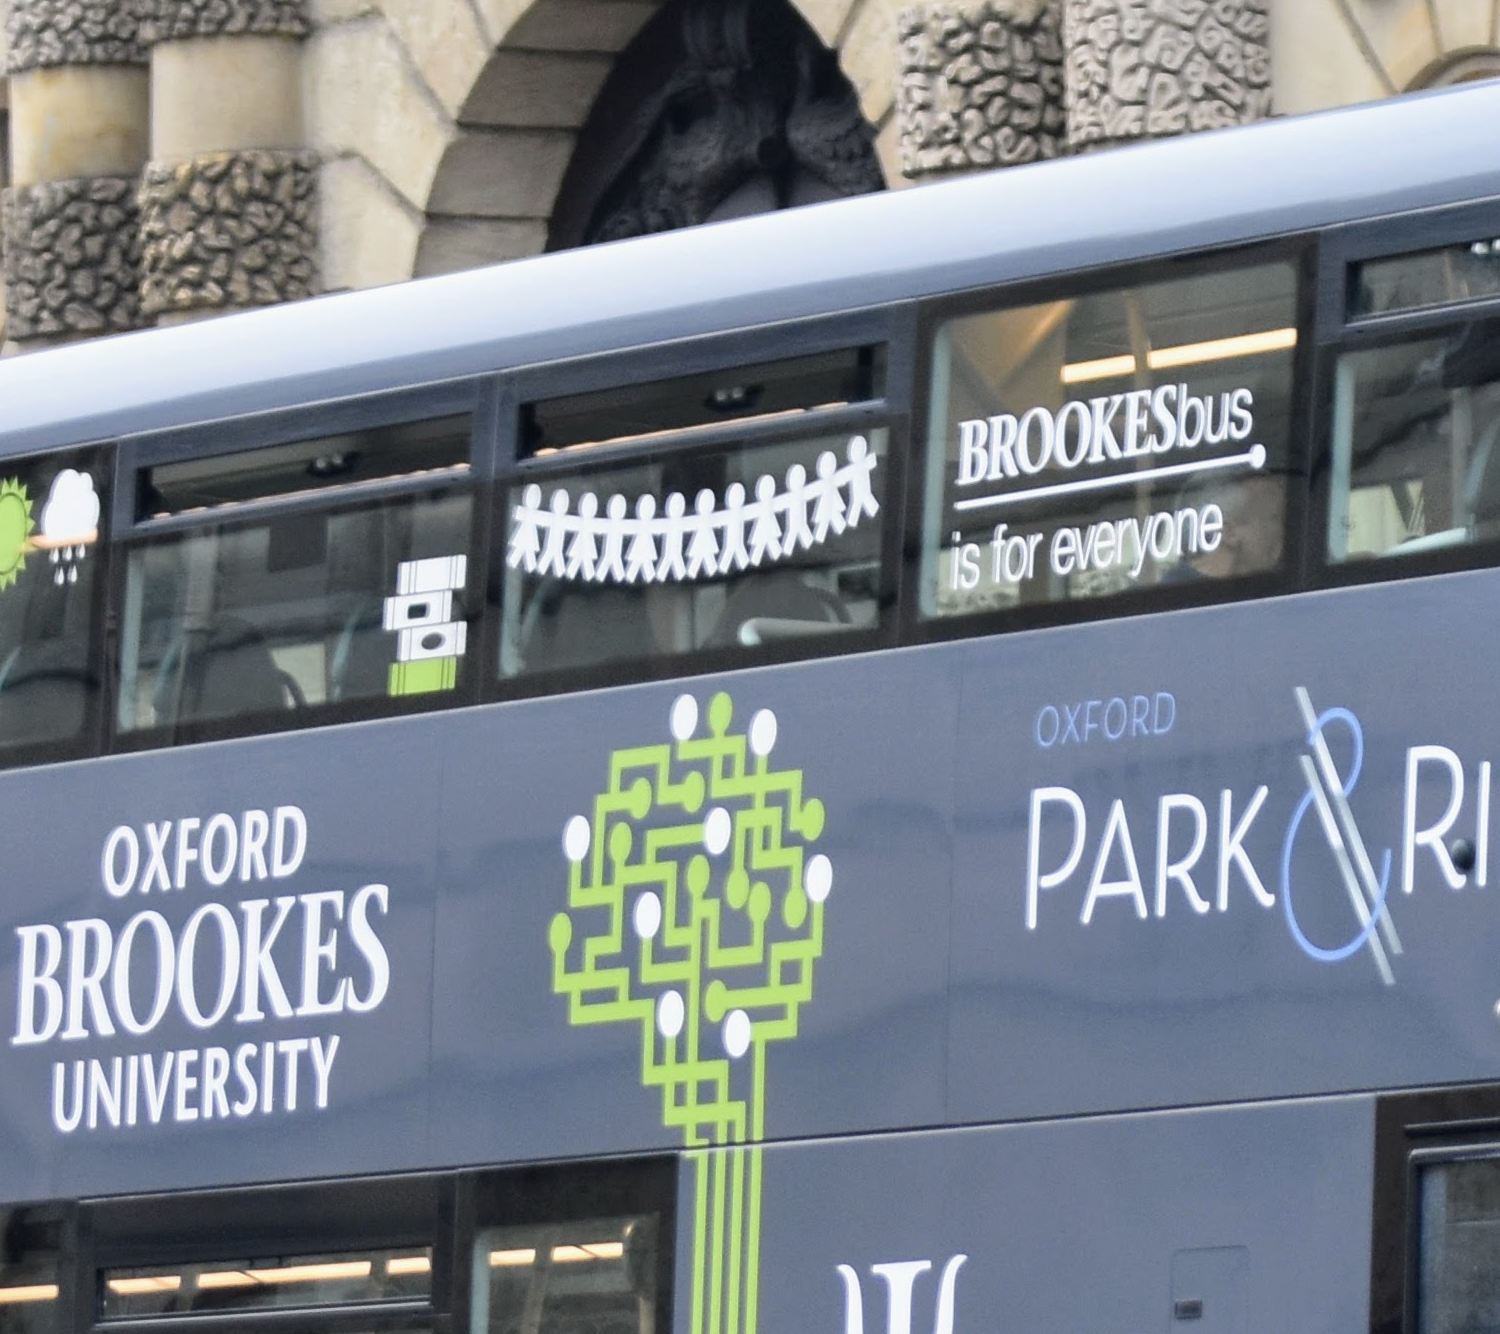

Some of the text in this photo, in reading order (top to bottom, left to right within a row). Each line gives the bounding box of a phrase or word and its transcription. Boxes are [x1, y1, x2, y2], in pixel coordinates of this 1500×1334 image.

[954, 383, 1254, 488] BROOKESbus
[948, 503, 1224, 591] is for everyone
[1034, 690, 1178, 750] OXFORD
[102, 805, 308, 898] OXFORD
[1025, 784, 1275, 931] PARK
[11, 884, 390, 1045] BROOKES
[52, 1035, 340, 1132] UNIVERSITY
